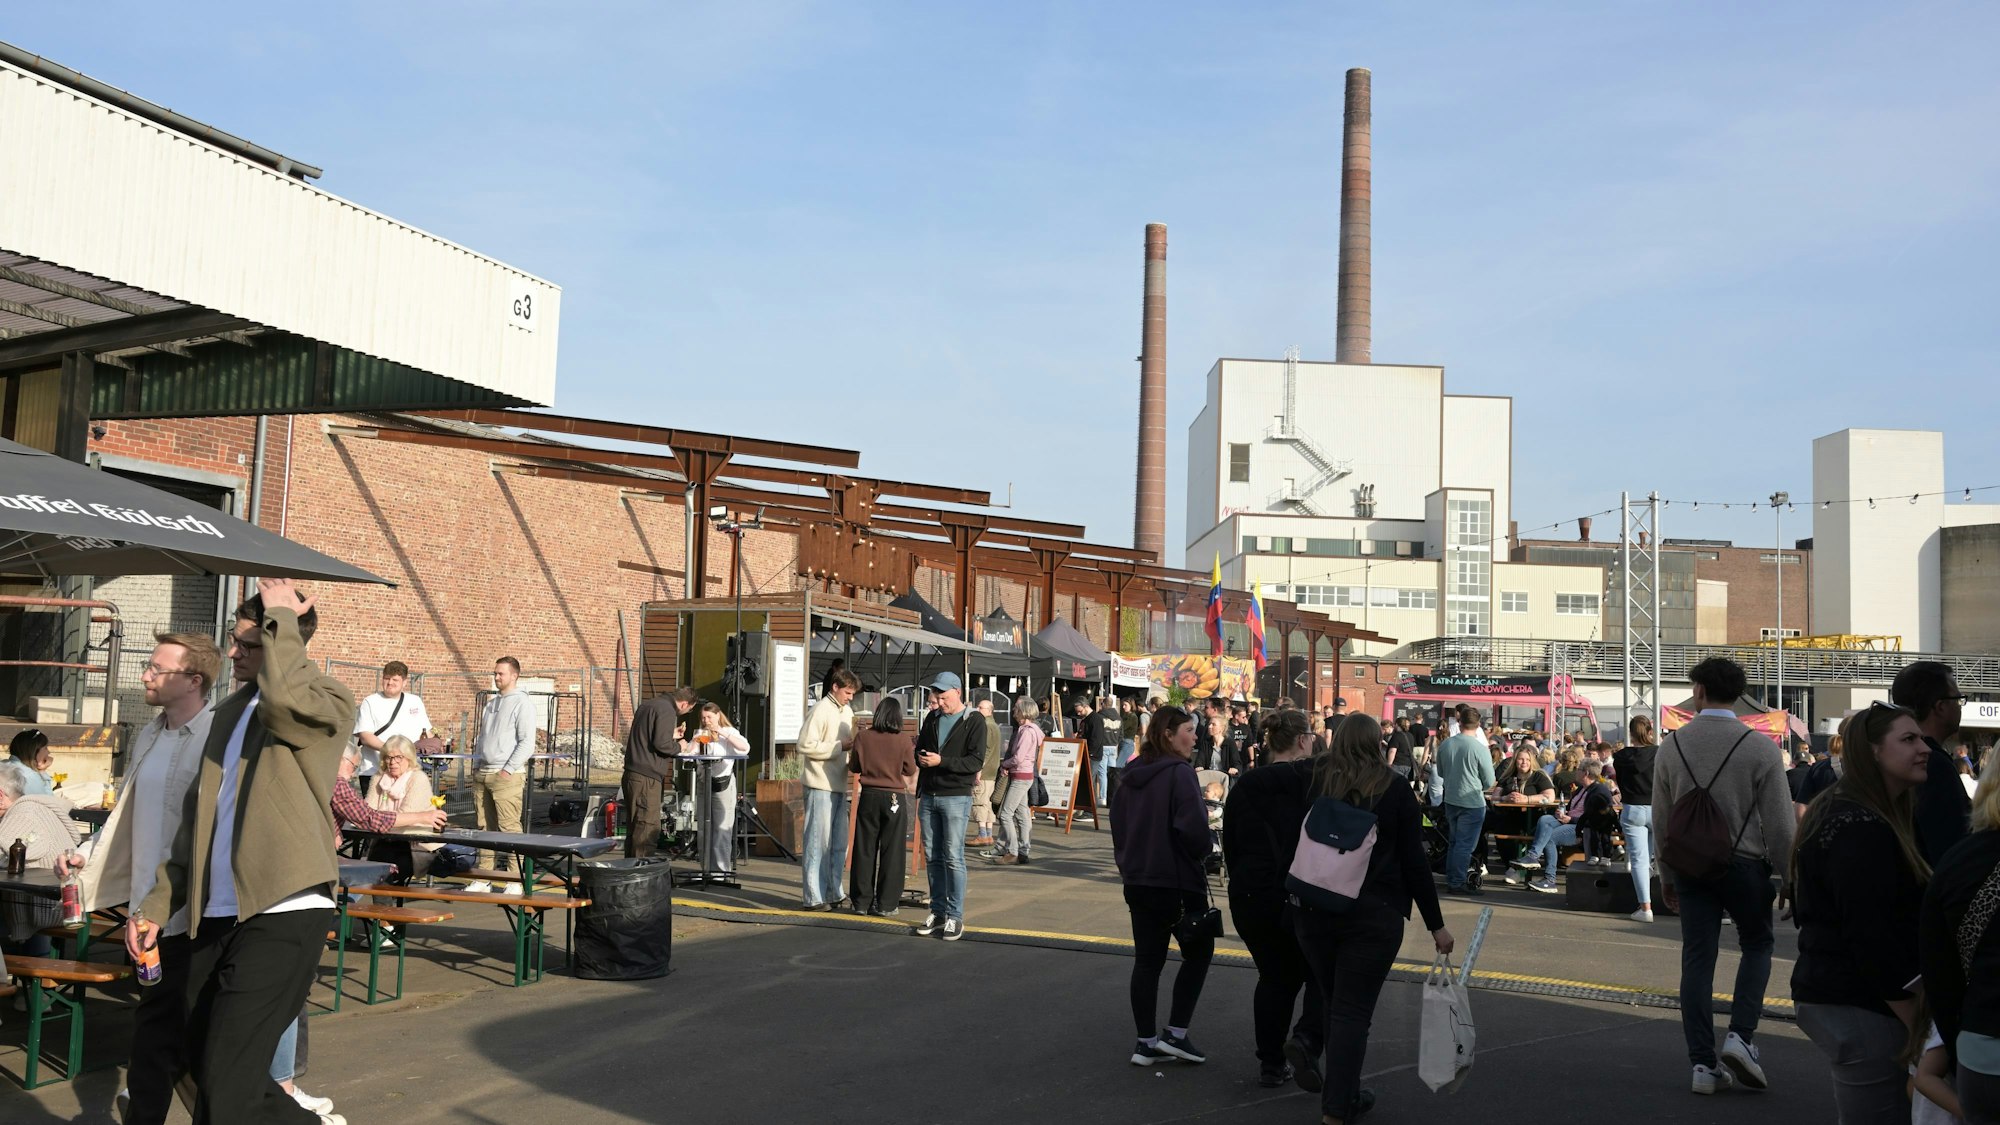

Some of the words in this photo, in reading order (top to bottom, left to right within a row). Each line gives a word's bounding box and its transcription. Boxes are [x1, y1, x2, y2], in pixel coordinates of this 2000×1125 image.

[513, 294, 532, 320] G3
[88, 503, 225, 539] Kölsch
[1005, 631, 1014, 646] Dog
[1430, 677, 1454, 685] LATIN
[1454, 678, 1499, 686] AMERICAN
[1470, 685, 1534, 693] SANDWICHERIA
[1979, 705, 2000, 717] COF
